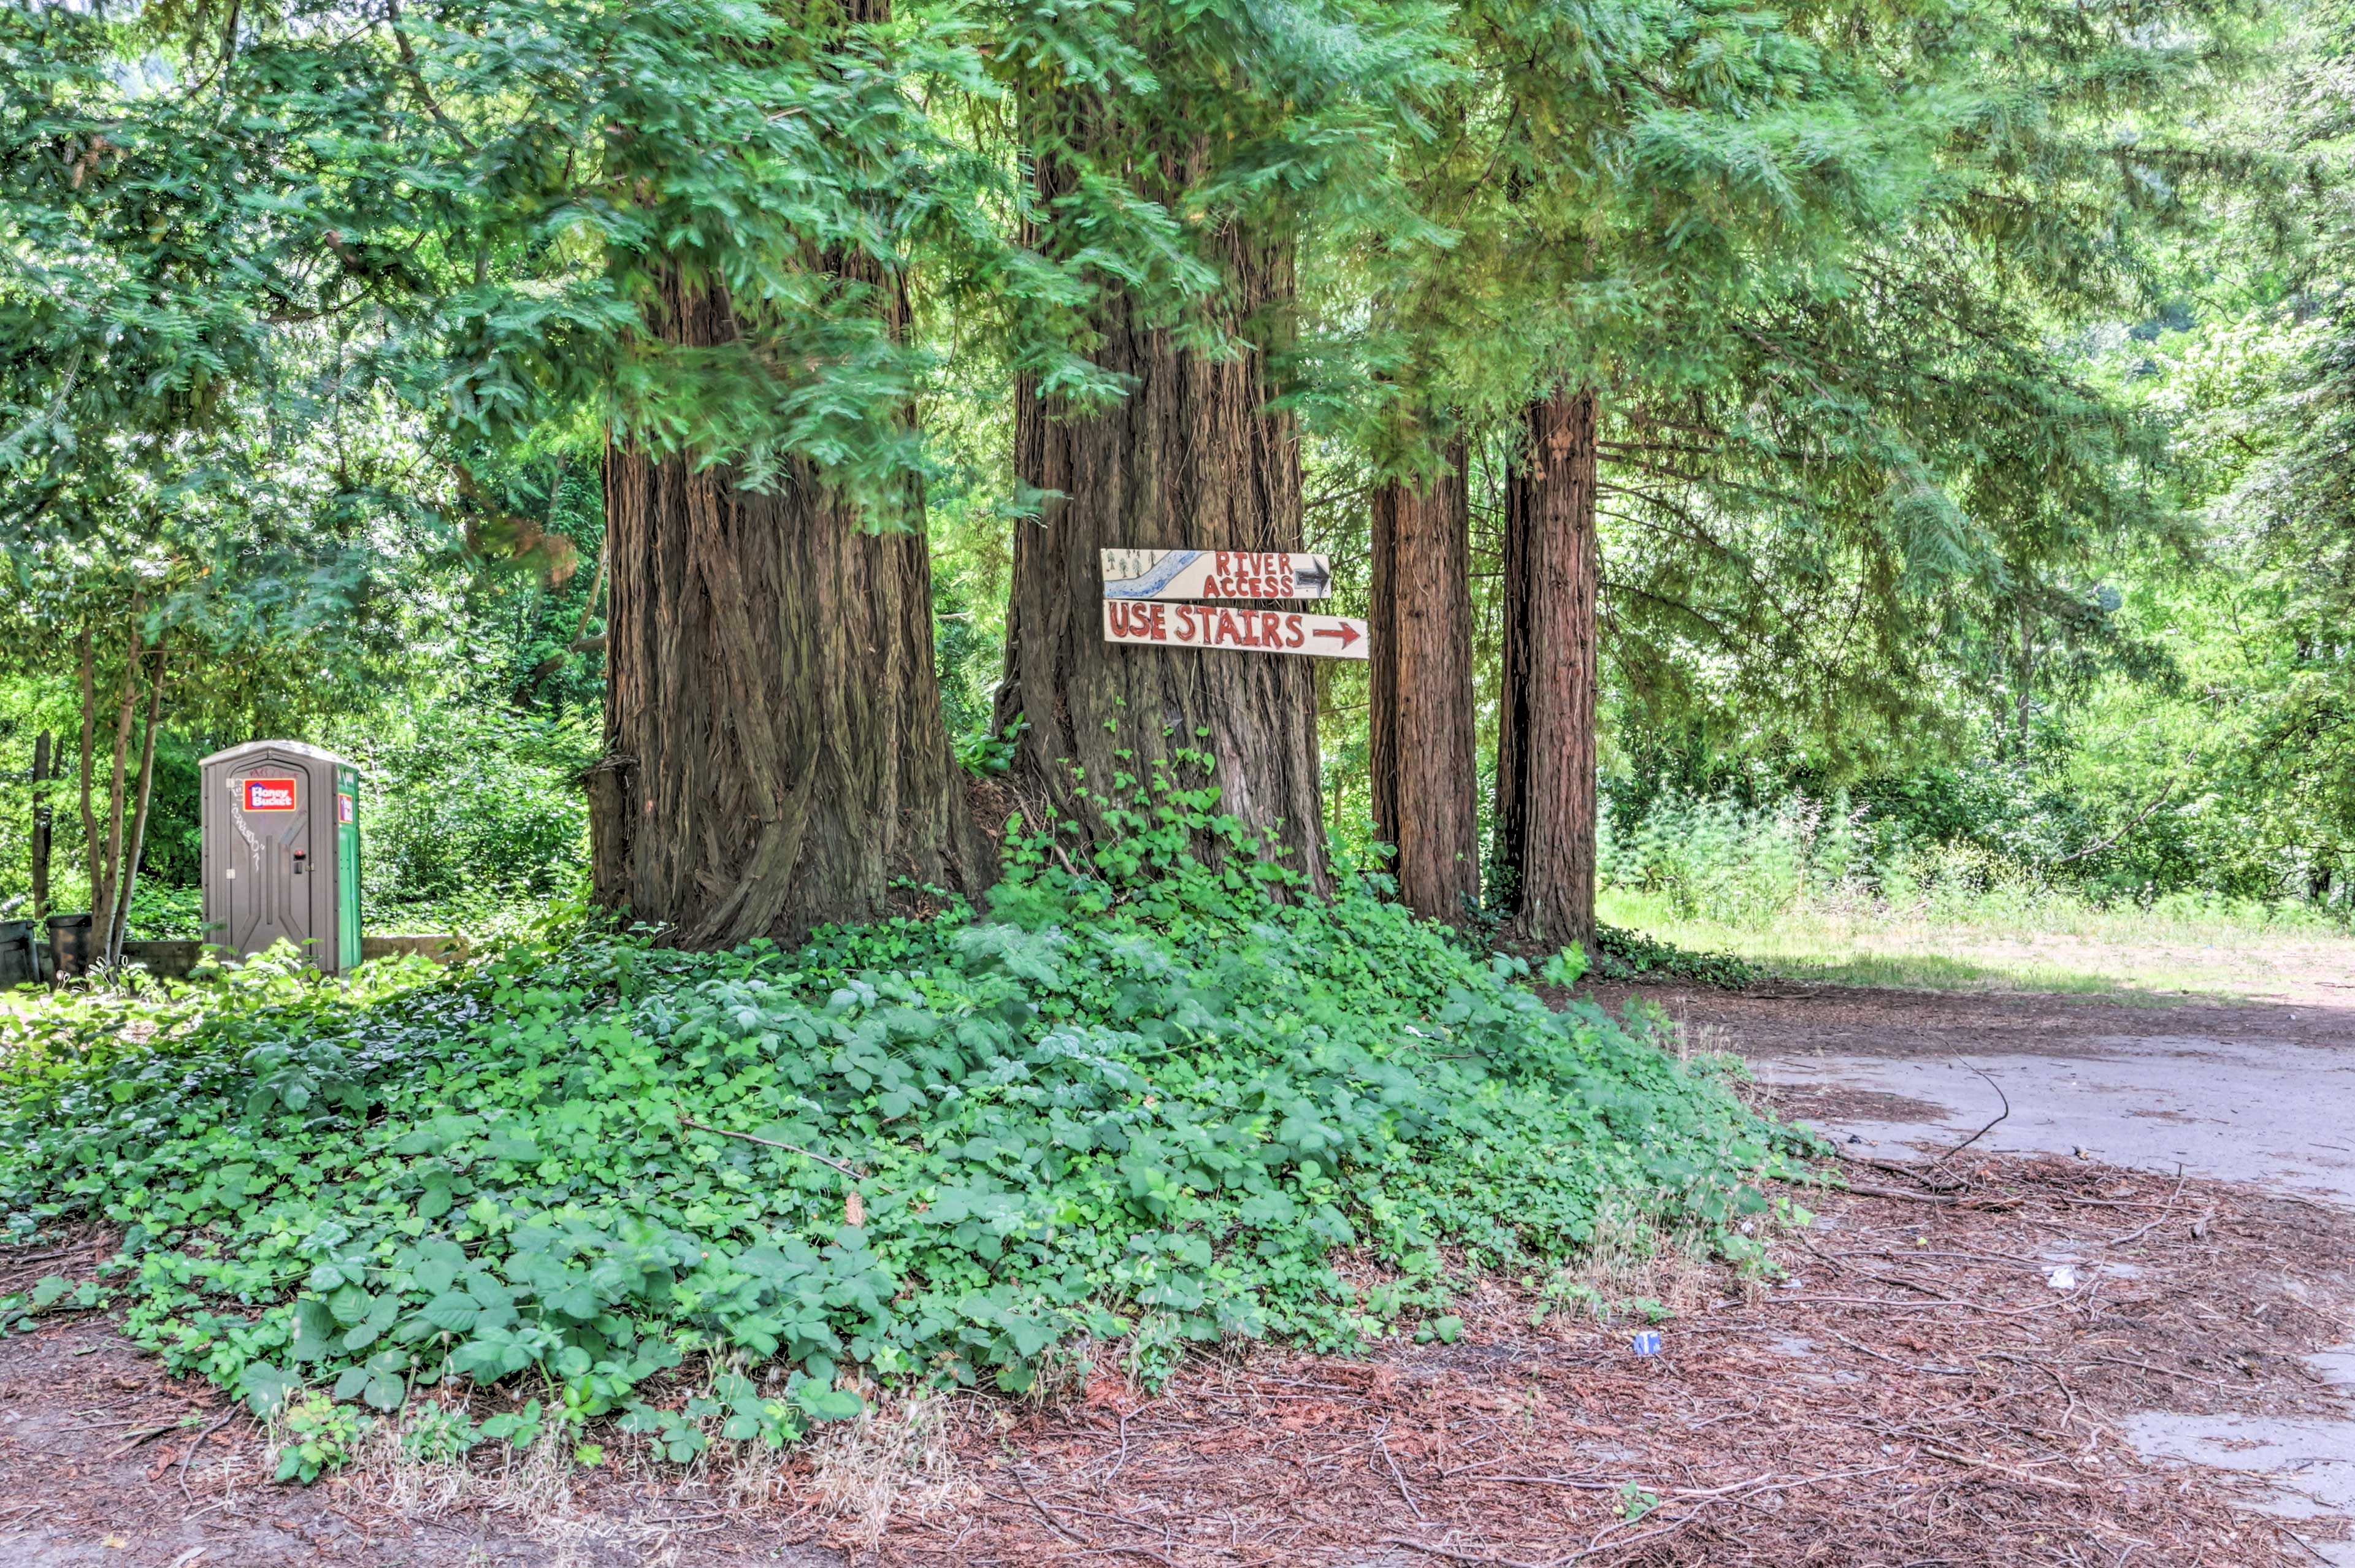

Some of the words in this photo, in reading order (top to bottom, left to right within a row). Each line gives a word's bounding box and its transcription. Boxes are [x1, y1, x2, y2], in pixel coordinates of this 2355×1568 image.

[1215, 552, 1294, 576] RIVER
[1203, 575, 1294, 599] ACCESS
[1108, 602, 1166, 640] USE
[1175, 604, 1305, 648] STAIRS
[251, 787, 289, 798] Honey
[252, 797, 292, 806] Bucket
